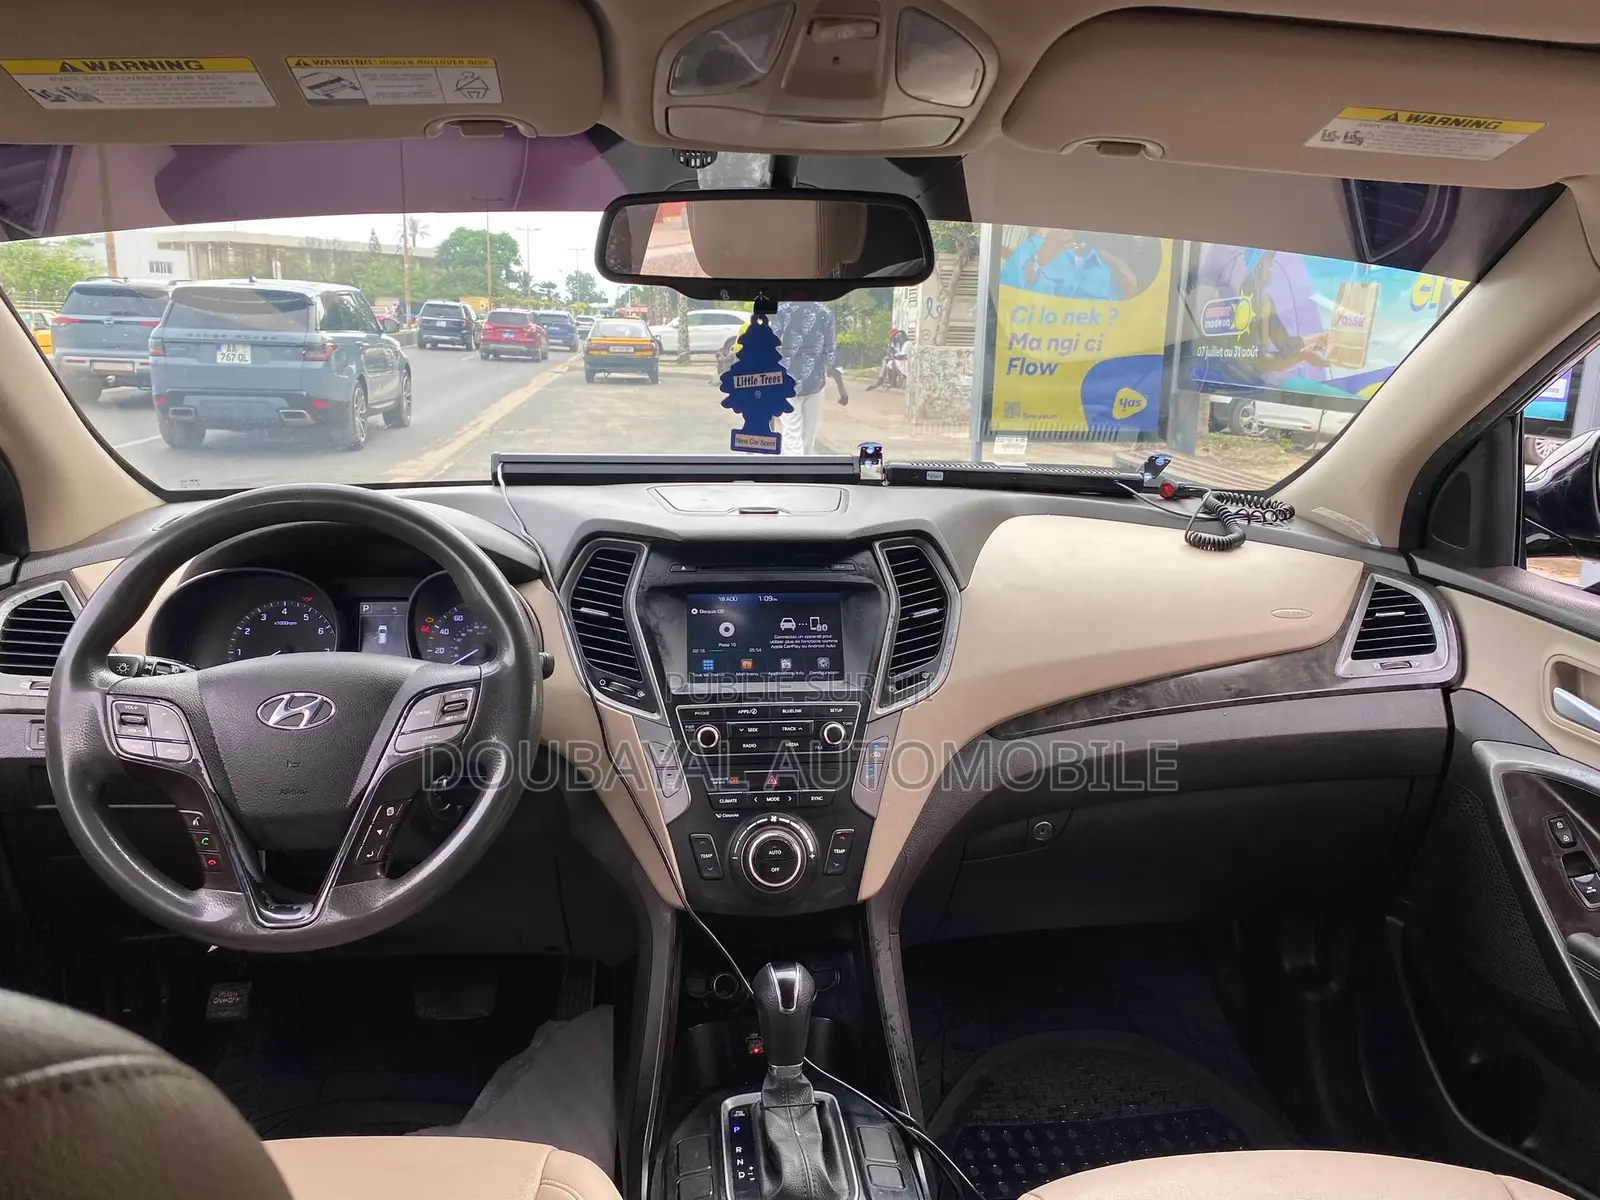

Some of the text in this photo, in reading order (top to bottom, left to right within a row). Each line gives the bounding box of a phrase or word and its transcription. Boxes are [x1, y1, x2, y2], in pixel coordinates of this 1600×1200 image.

[82, 60, 205, 72] WARNING
[1405, 113, 1503, 130] WARNING
[1010, 304, 1035, 325] Ci
[1038, 306, 1058, 325] lo
[1061, 307, 1100, 326] nek
[226, 343, 237, 353] AA
[1008, 332, 1104, 356] Ma ngi ci
[1197, 345, 1206, 357] 07
[1223, 348, 1233, 357] au
[1233, 345, 1241, 357] 31
[1241, 345, 1260, 357] août
[220, 352, 236, 363] 767
[1006, 356, 1059, 376] Flow
[736, 373, 781, 387] Little Trees
[1119, 396, 1141, 412] yas
[736, 436, 776, 448] New Car Scent
[362, 604, 370, 612] P
[236, 648, 242, 656] 1
[736, 1158, 744, 1166] N
[738, 1171, 745, 1179] D
